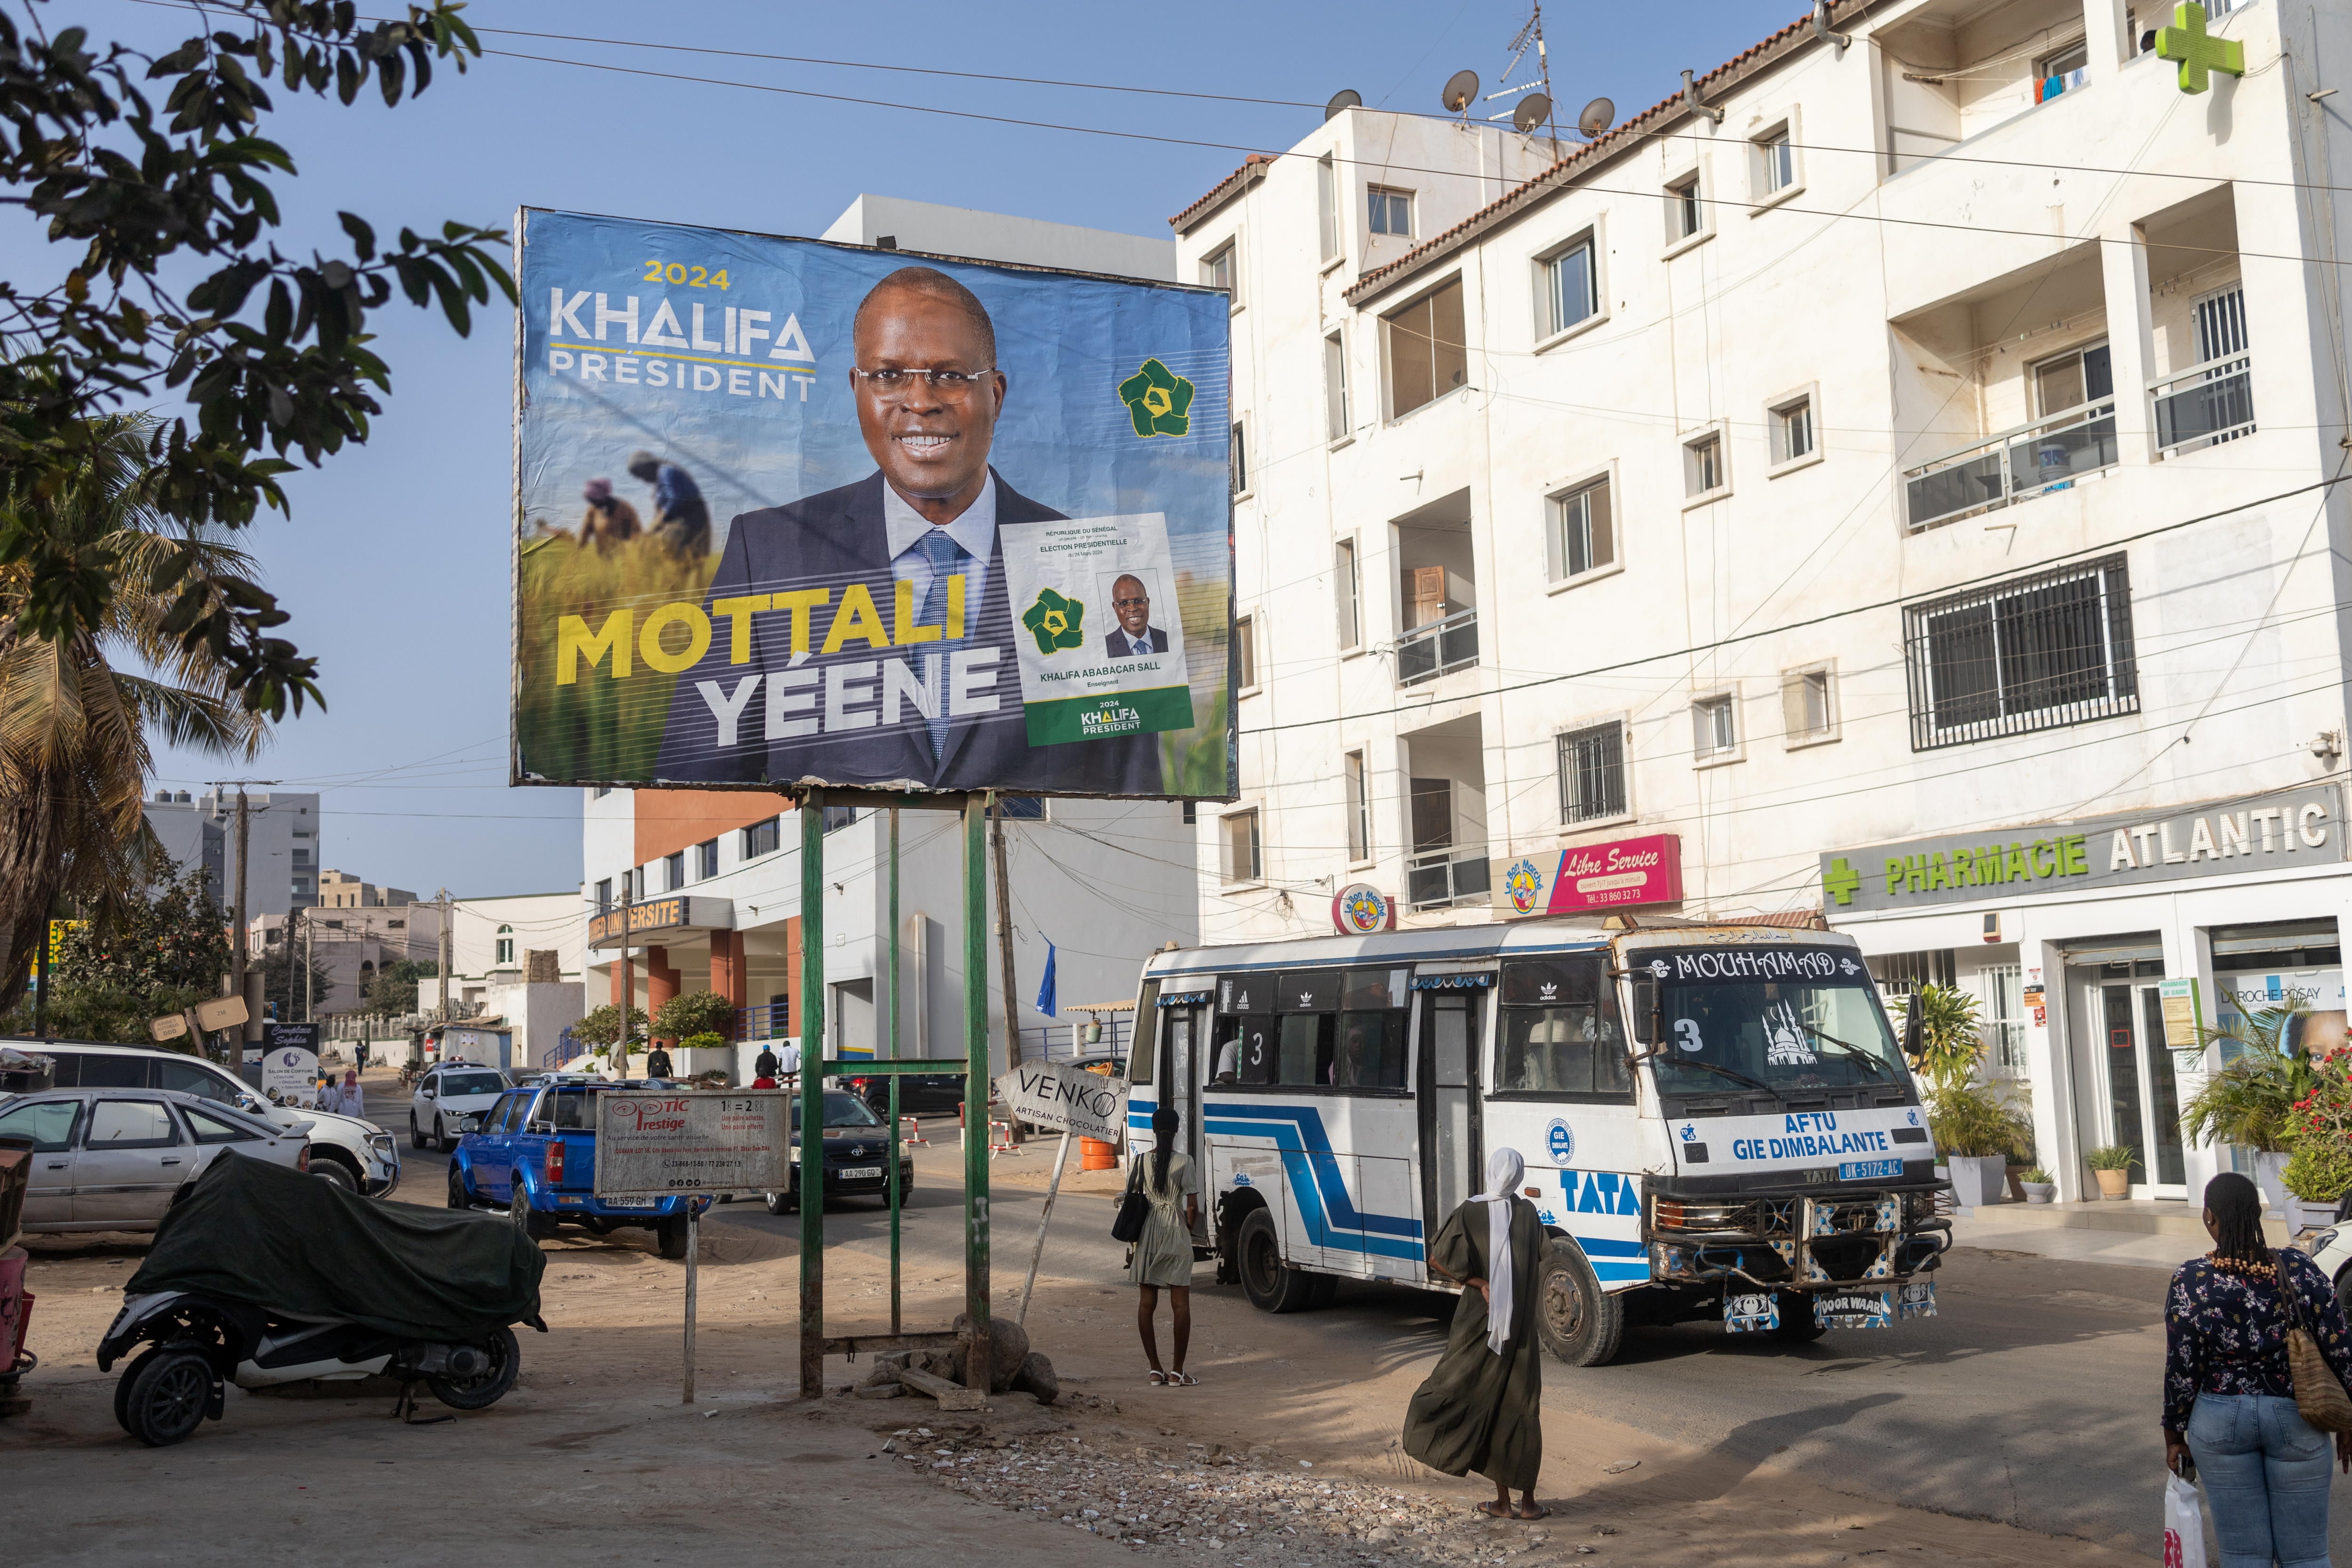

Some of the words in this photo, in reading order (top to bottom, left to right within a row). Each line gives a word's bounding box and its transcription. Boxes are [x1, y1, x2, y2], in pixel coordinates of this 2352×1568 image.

[644, 261, 730, 290] 2024
[550, 287, 815, 363] KHALIFA
[549, 350, 816, 402] PRÉSIDENT
[1074, 539, 1127, 549] PRESIDENTIELLE
[557, 574, 965, 685] MOTTALI
[1041, 670, 1080, 682] KHALIFA
[1082, 664, 1135, 677] ABABACAR
[1137, 662, 1160, 671] SALL
[694, 650, 1000, 747] YÉENE
[1081, 707, 1140, 725] KHALIFA
[1083, 722, 1140, 735] PRESIDENT
[1885, 833, 2088, 894] PHARMACIE
[2110, 803, 2328, 870] ATLANTIC
[1507, 863, 1519, 880] Bon
[1565, 853, 1601, 877] Libre
[1607, 848, 1659, 871] Service
[1523, 859, 1543, 890] Marché
[1607, 877, 1623, 887] jusqu'à
[1505, 882, 1510, 894] Le
[1586, 894, 1598, 904] Tél.:
[1600, 893, 1607, 902] 33
[1609, 891, 1621, 901] 860
[1623, 890, 1631, 899] 32
[1632, 889, 1640, 898] 73
[1344, 904, 1351, 913] Le
[1349, 892, 1362, 903] Bon
[1366, 891, 1386, 916] Marché
[1675, 952, 1836, 979] MOUHAMAD
[2237, 989, 2279, 1002] ROCHE
[2280, 987, 2320, 1000] POSAY
[271, 1025, 311, 1035] Complexe
[275, 1035, 307, 1046] Sophia
[1674, 1019, 1703, 1051] 3
[1251, 1033, 1263, 1065] 3
[1020, 1069, 1116, 1117] VENKO
[722, 1101, 725, 1111] 1
[746, 1100, 752, 1111] 2
[1016, 1106, 1053, 1121] ARTISAN
[1057, 1116, 1119, 1138] CHOCOLATIER
[1786, 1112, 1836, 1133] AFTU
[1733, 1139, 1766, 1160] GIE
[1768, 1131, 1888, 1159] DIMBALANTE
[1804, 1168, 1839, 1183] TATA
[1845, 1161, 1898, 1178] DK-5172-AC
[1560, 1170, 1641, 1216] TATA
[1821, 1297, 1849, 1314] DOOR
[1850, 1297, 1880, 1315] WAAR
